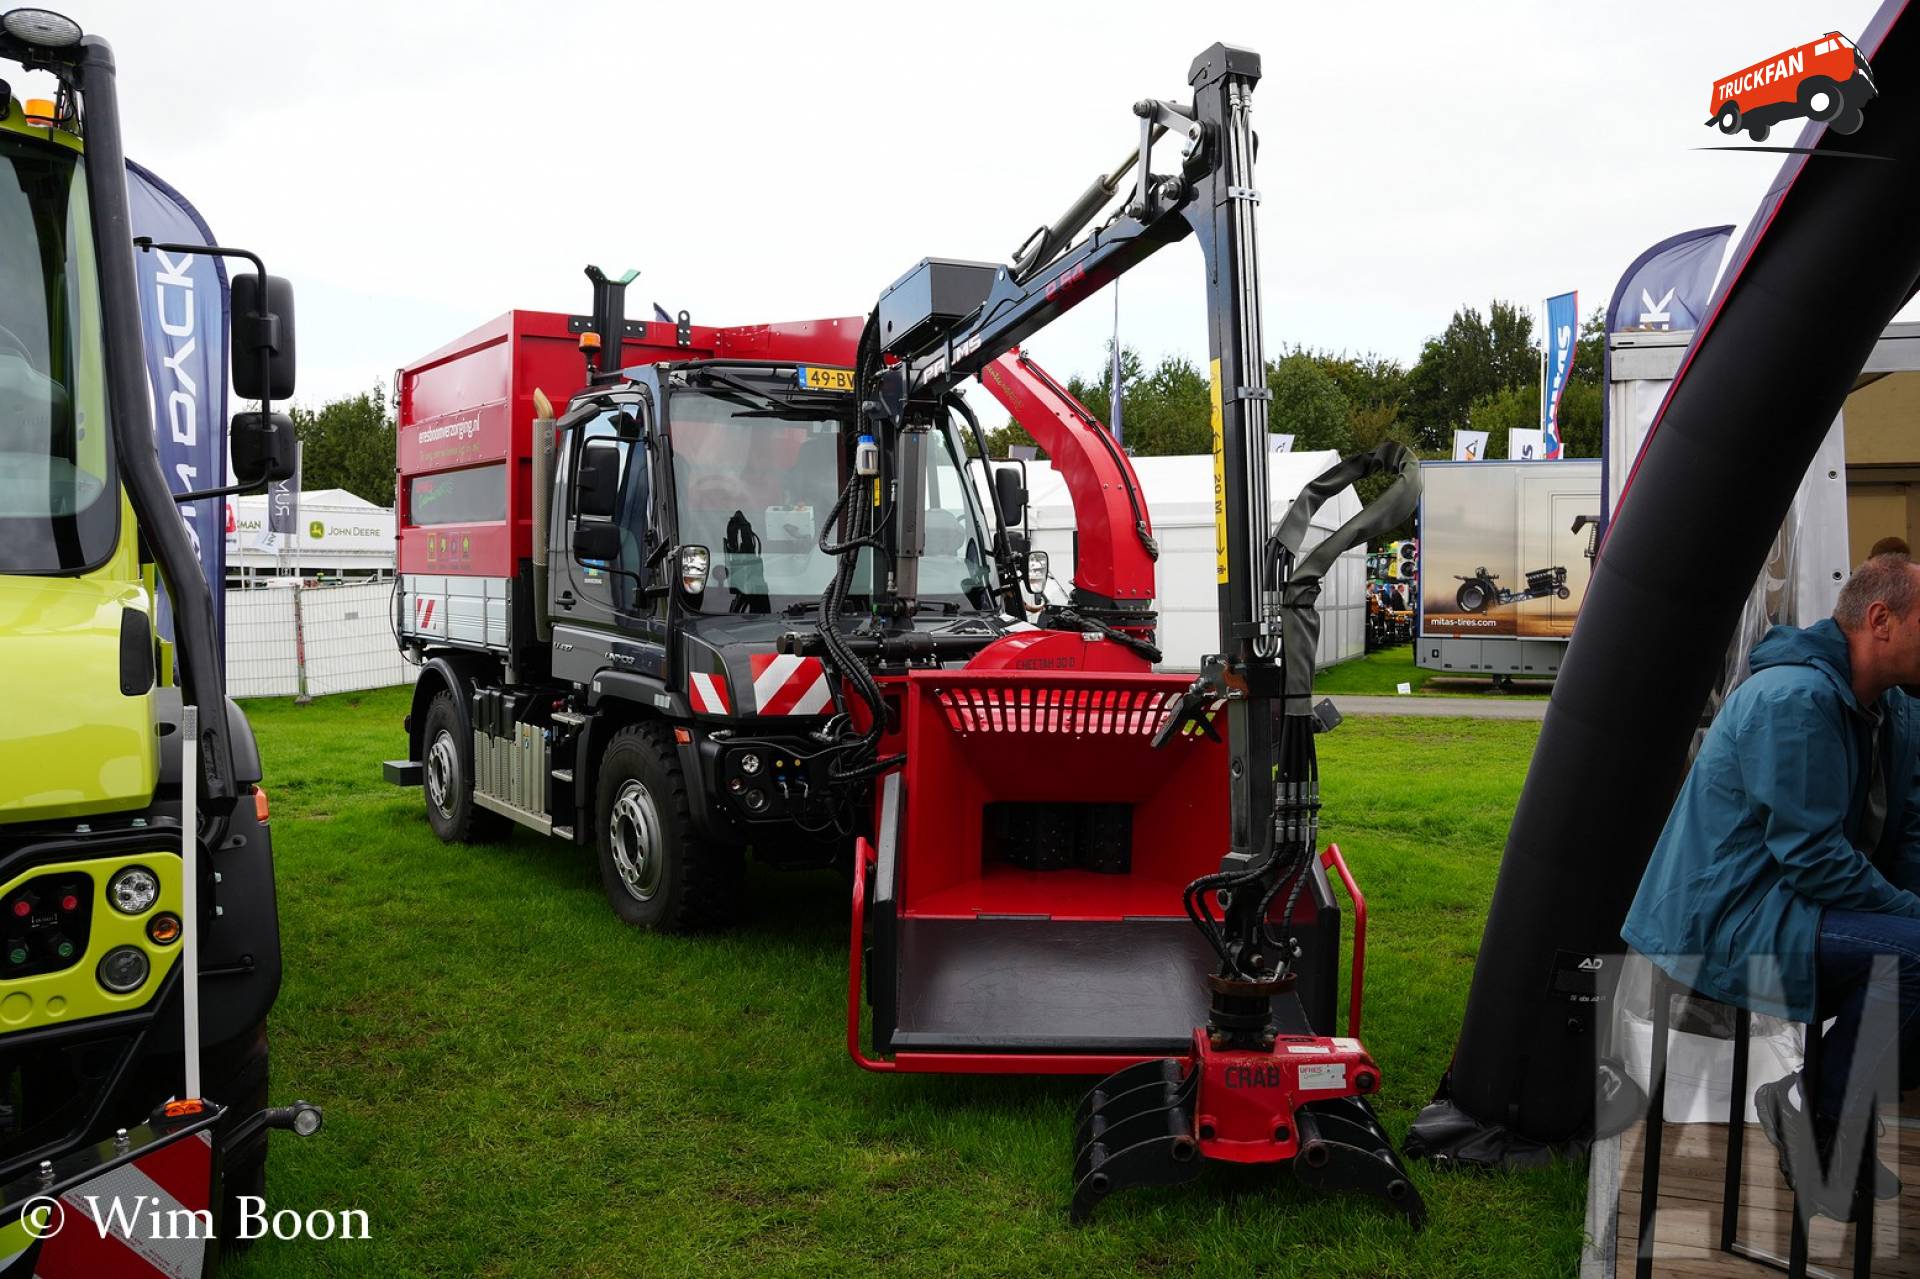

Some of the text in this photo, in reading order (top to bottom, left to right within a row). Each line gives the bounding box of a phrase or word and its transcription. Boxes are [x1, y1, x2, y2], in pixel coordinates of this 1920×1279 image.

[328, 527, 381, 537] JOHN DEERE
[1431, 618, 1497, 627] mitas-tires.com
[1224, 1065, 1281, 1089] CRAB
